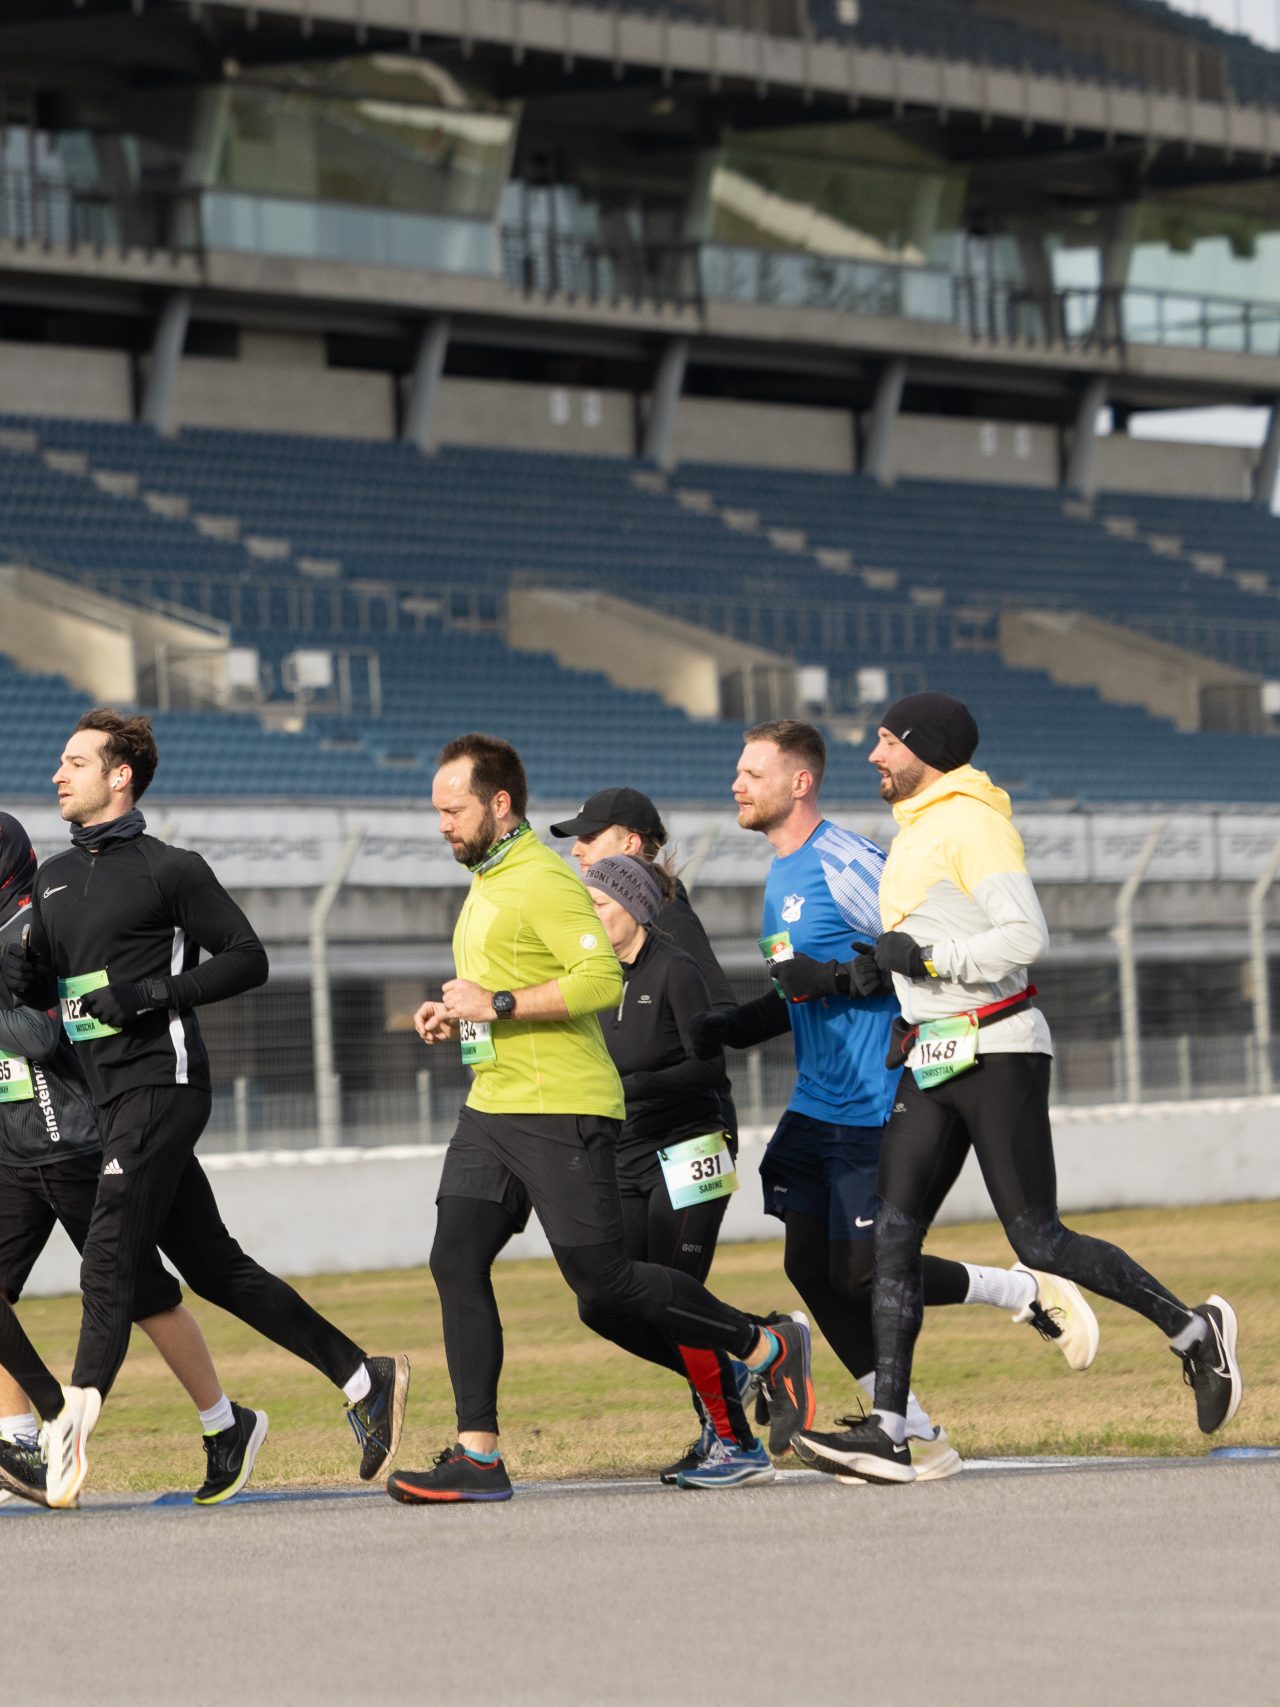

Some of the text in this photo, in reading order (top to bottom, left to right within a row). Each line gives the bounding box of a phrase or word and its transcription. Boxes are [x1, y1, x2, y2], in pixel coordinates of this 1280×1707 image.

[619, 869, 642, 891] MARA
[611, 880, 634, 903] MARA
[75, 1021, 96, 1033] MISCHA
[921, 1040, 957, 1065] 1148
[922, 1065, 955, 1080] CHRISTIAN
[691, 1155, 721, 1181] 331
[699, 1180, 724, 1194] SABINE
